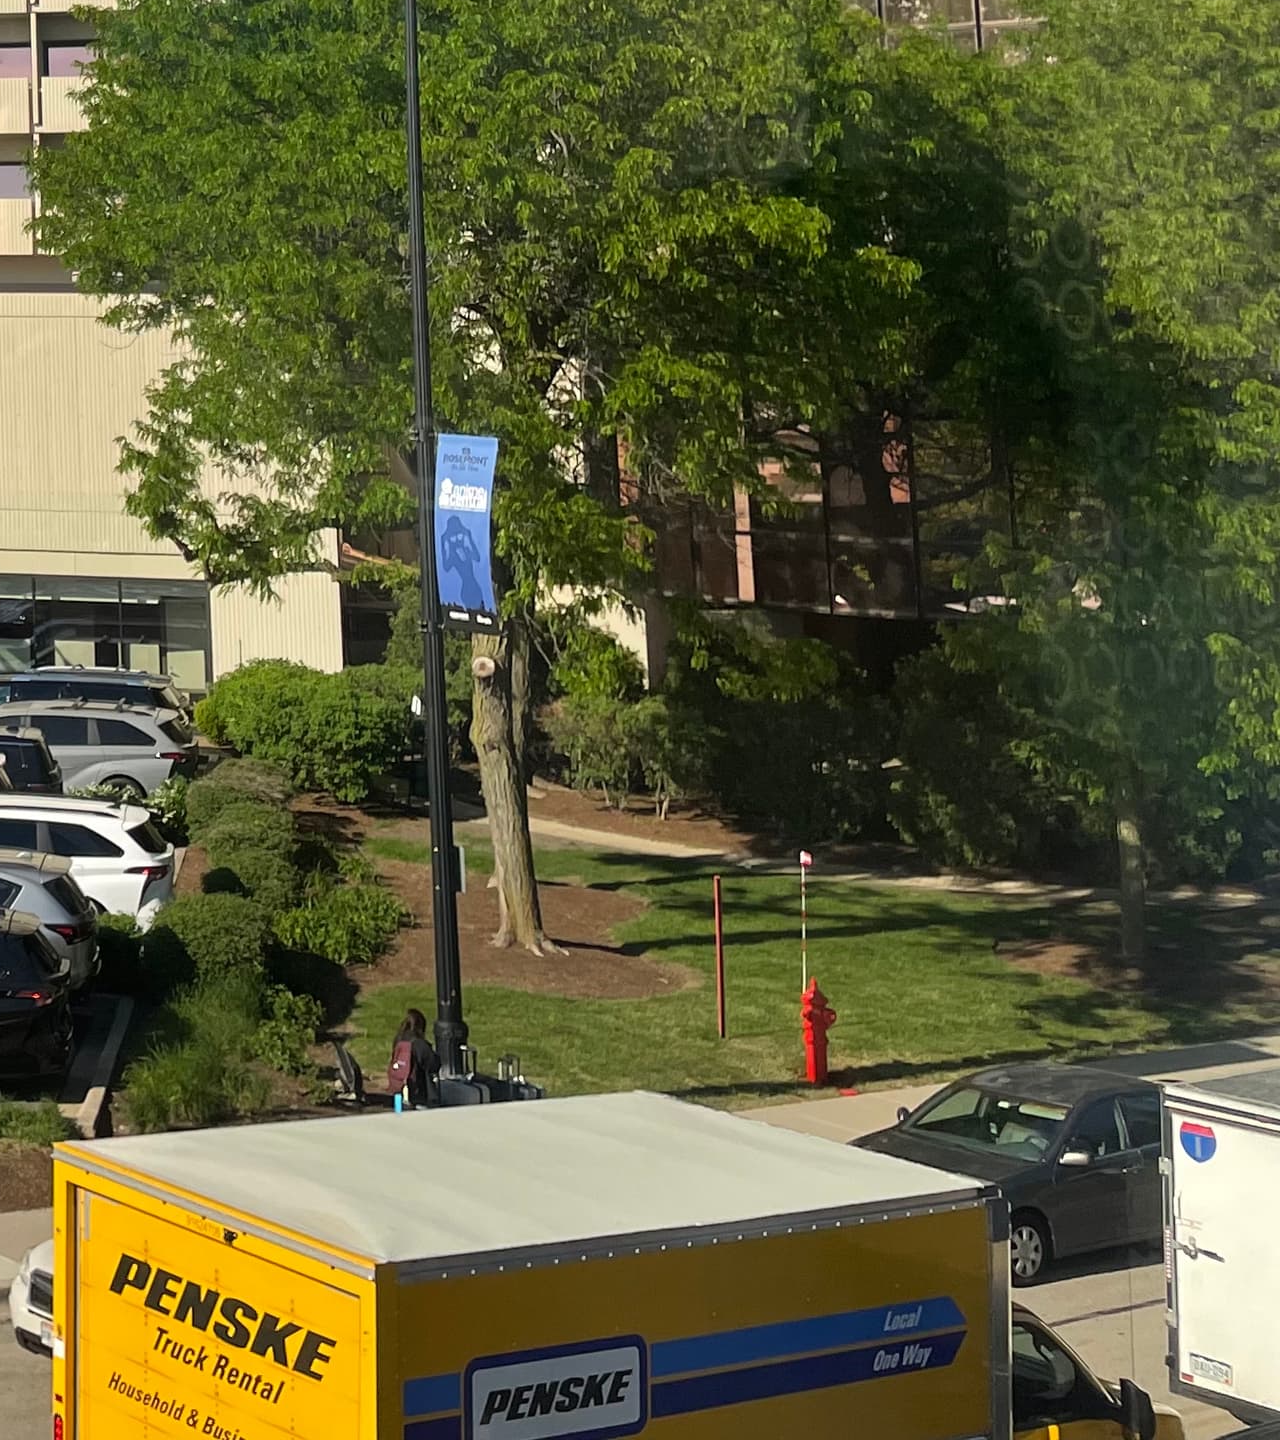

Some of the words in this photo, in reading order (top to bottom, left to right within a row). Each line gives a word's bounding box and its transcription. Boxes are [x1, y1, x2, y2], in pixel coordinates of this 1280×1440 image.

[108, 1252, 338, 1382] PENSKE
[883, 1304, 923, 1332] Local
[153, 1326, 209, 1372] Truck
[212, 1354, 286, 1404] Rental
[872, 1349, 900, 1372] One
[901, 1343, 933, 1367] Way
[107, 1371, 186, 1421] Household
[185, 1408, 199, 1429] &
[202, 1416, 247, 1440] Busi
[479, 1368, 634, 1426] PENSKE
